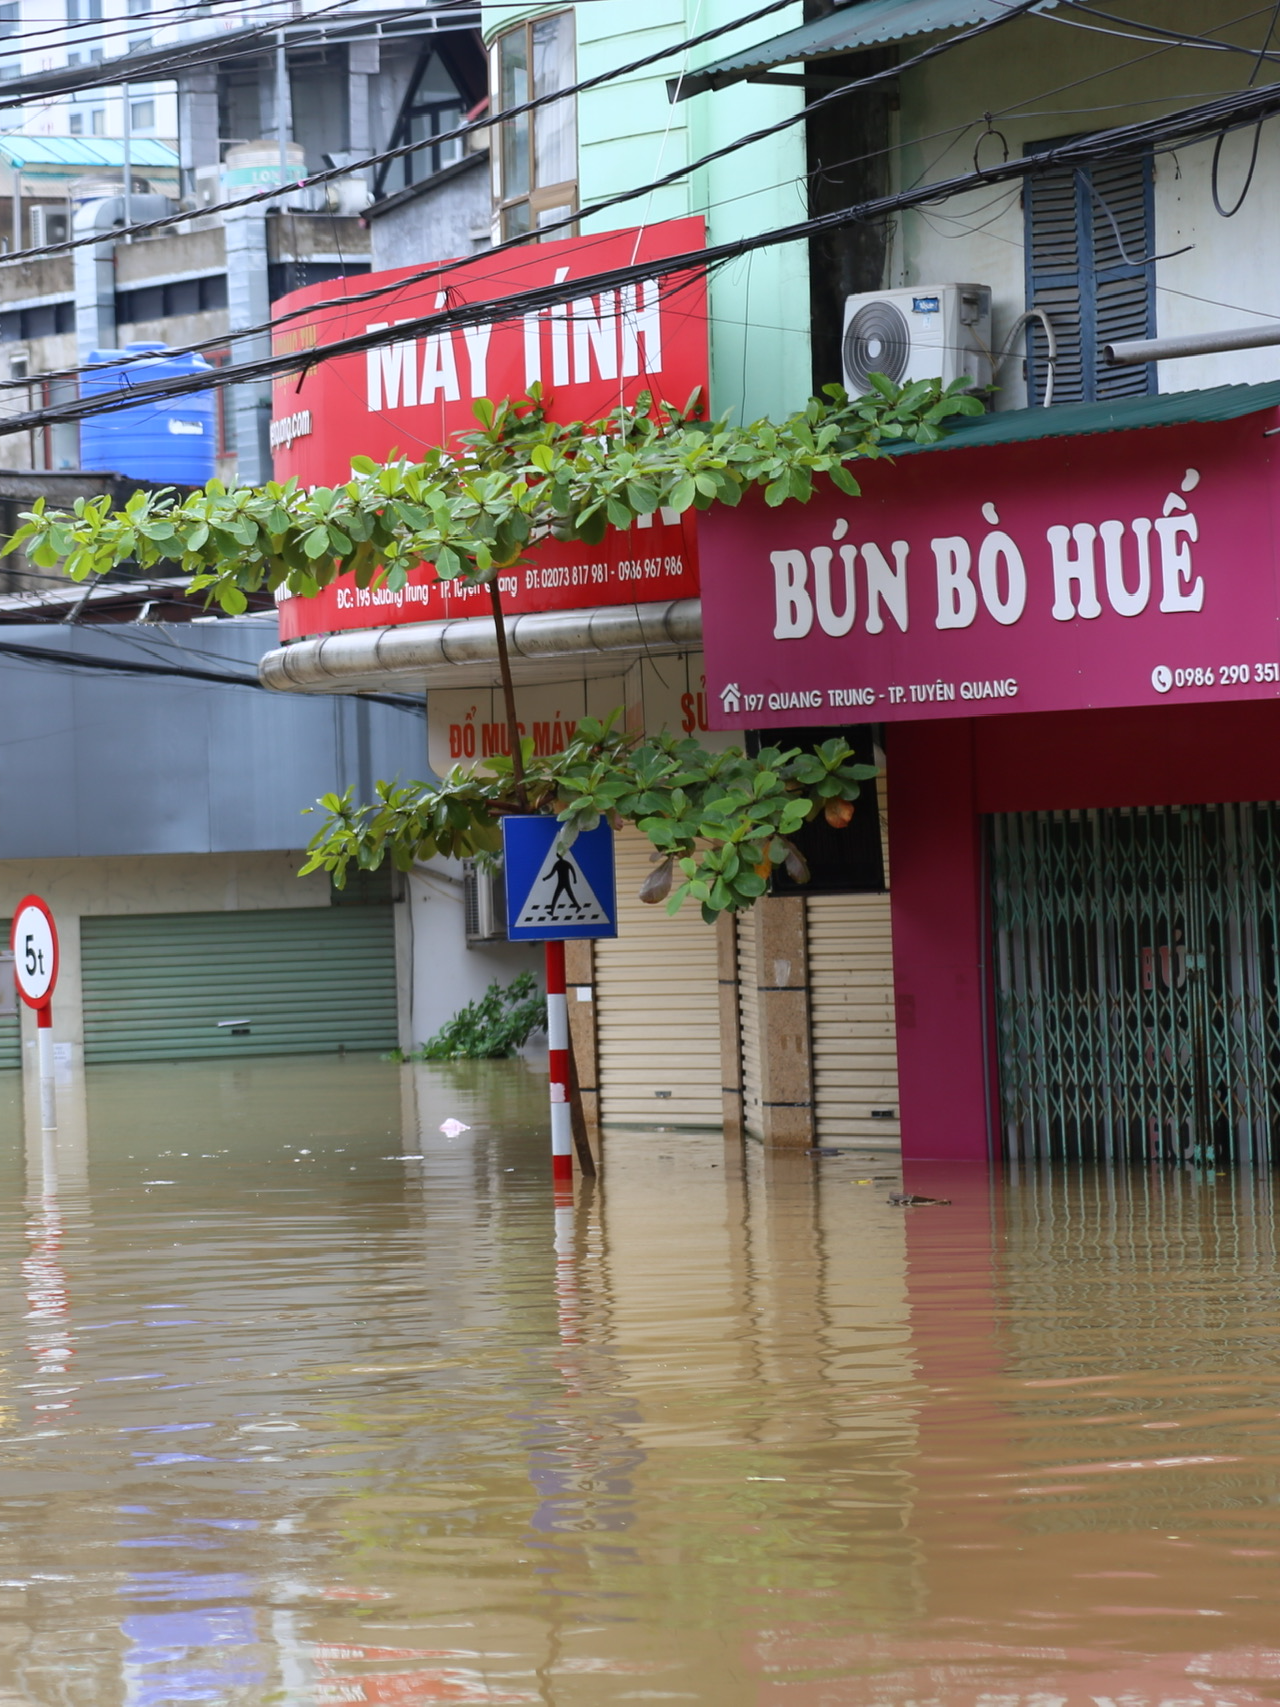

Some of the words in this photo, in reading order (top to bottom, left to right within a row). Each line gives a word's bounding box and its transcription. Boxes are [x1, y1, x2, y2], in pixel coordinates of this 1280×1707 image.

[366, 290, 495, 413] MÁY
[523, 266, 663, 391] TÍNH
[770, 517, 910, 640] BÚN
[931, 501, 1027, 630] BÒ
[1046, 468, 1205, 622] HUẾ
[355, 587, 370, 607] 195
[405, 582, 429, 606] Trung
[541, 567, 570, 588] 02073
[572, 565, 589, 586] 817
[591, 563, 609, 584] 981
[644, 558, 662, 579] 967
[664, 555, 684, 577] 986
[743, 693, 765, 712] 197
[768, 690, 823, 711] QUANG
[828, 687, 875, 707] TRUNG
[888, 686, 907, 704] TP.
[910, 679, 955, 703] TUYÊN
[960, 678, 1018, 700] QUANG
[1175, 667, 1215, 687] 0986
[1219, 664, 1250, 685] 290
[1254, 663, 1279, 683] 351
[449, 705, 477, 759] ĐỔ
[25, 934, 45, 976] 5t
